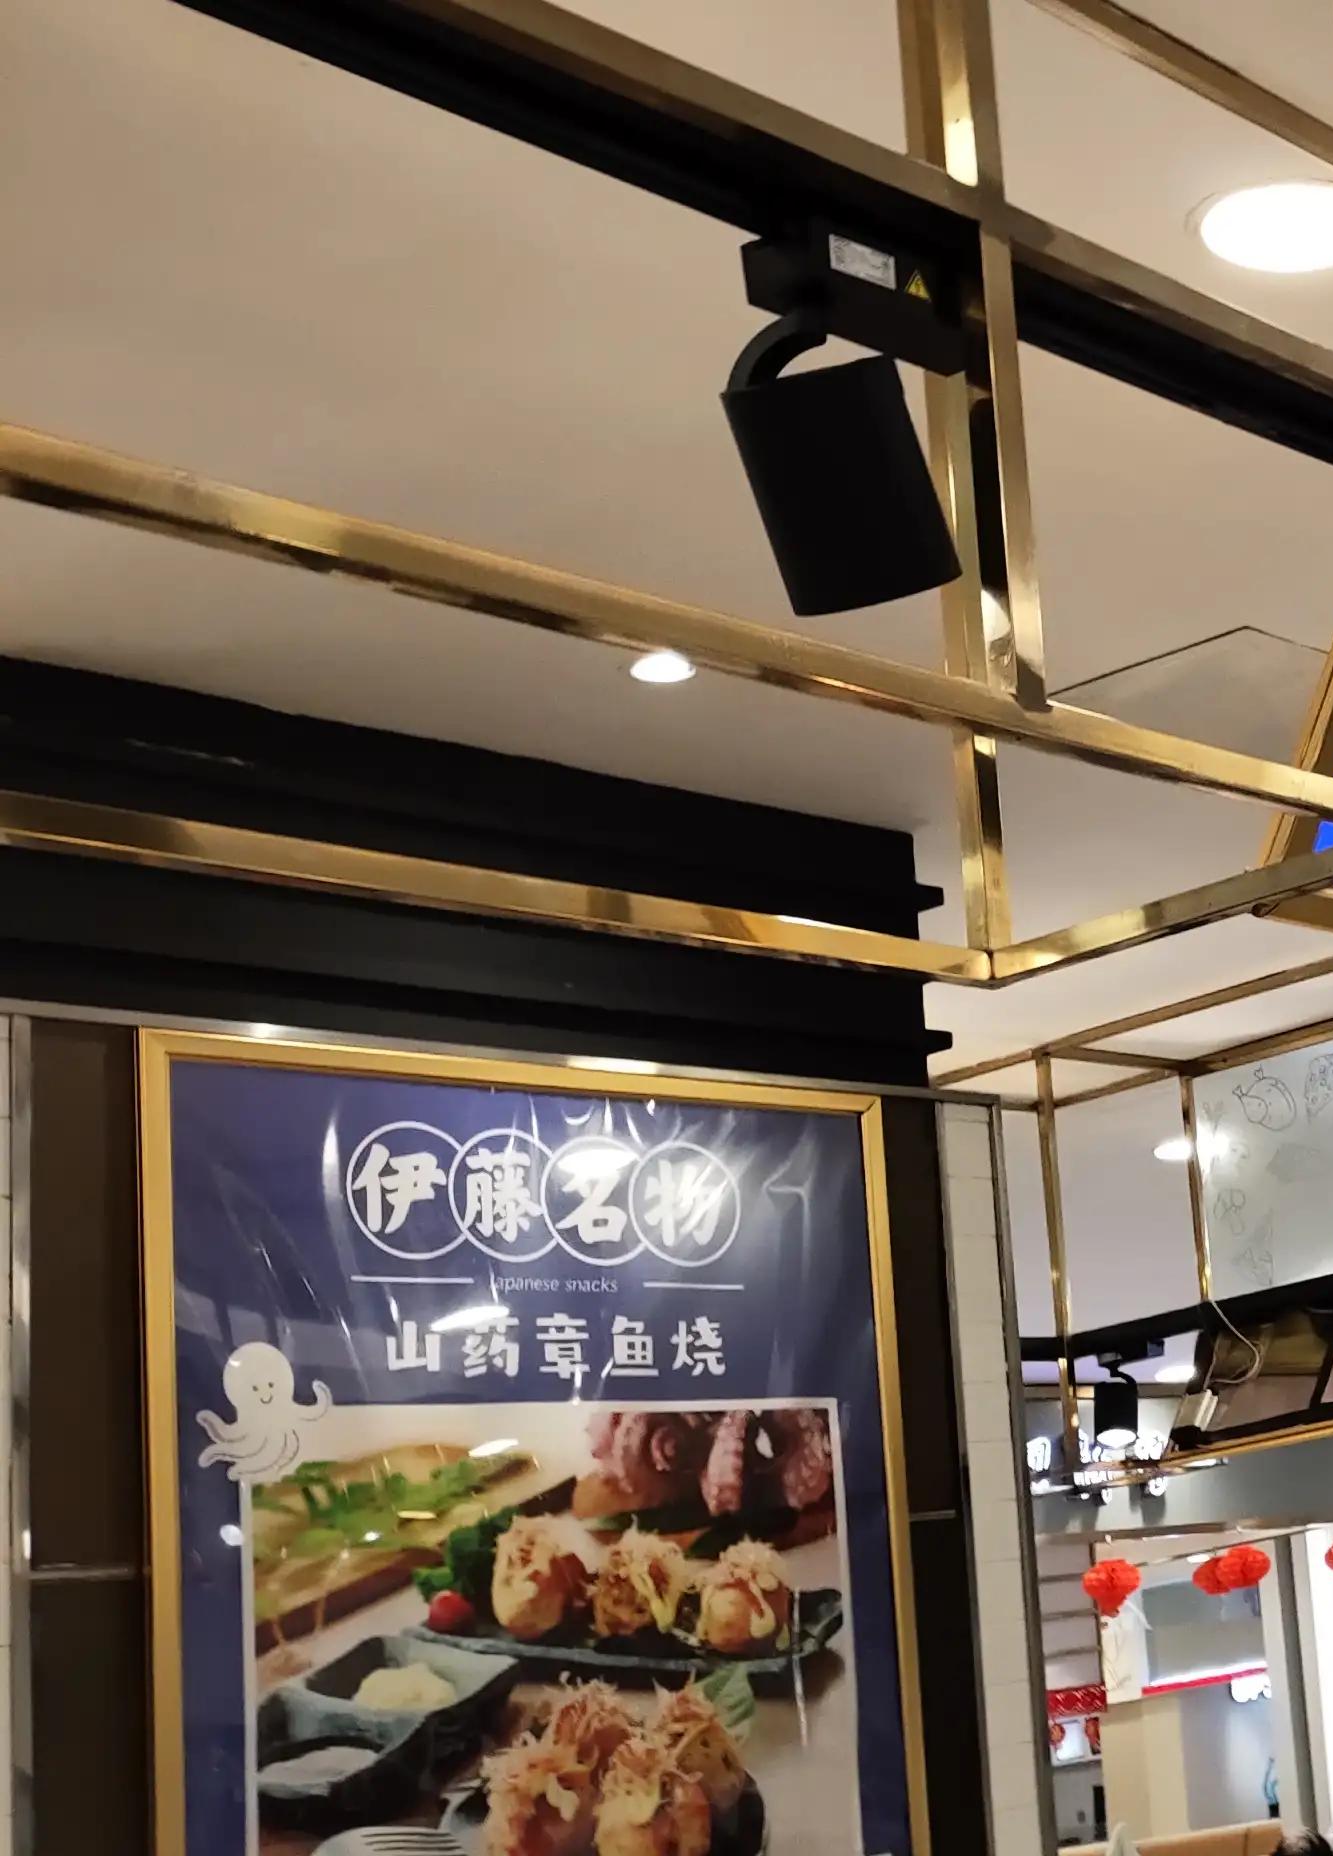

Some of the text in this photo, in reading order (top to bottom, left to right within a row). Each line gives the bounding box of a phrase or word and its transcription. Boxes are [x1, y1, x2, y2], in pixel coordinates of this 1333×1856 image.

[351, 1142, 728, 1247] 伊藤名物
[564, 1277, 619, 1294] snacks
[385, 1312, 727, 1379] 山药章鱼烧
